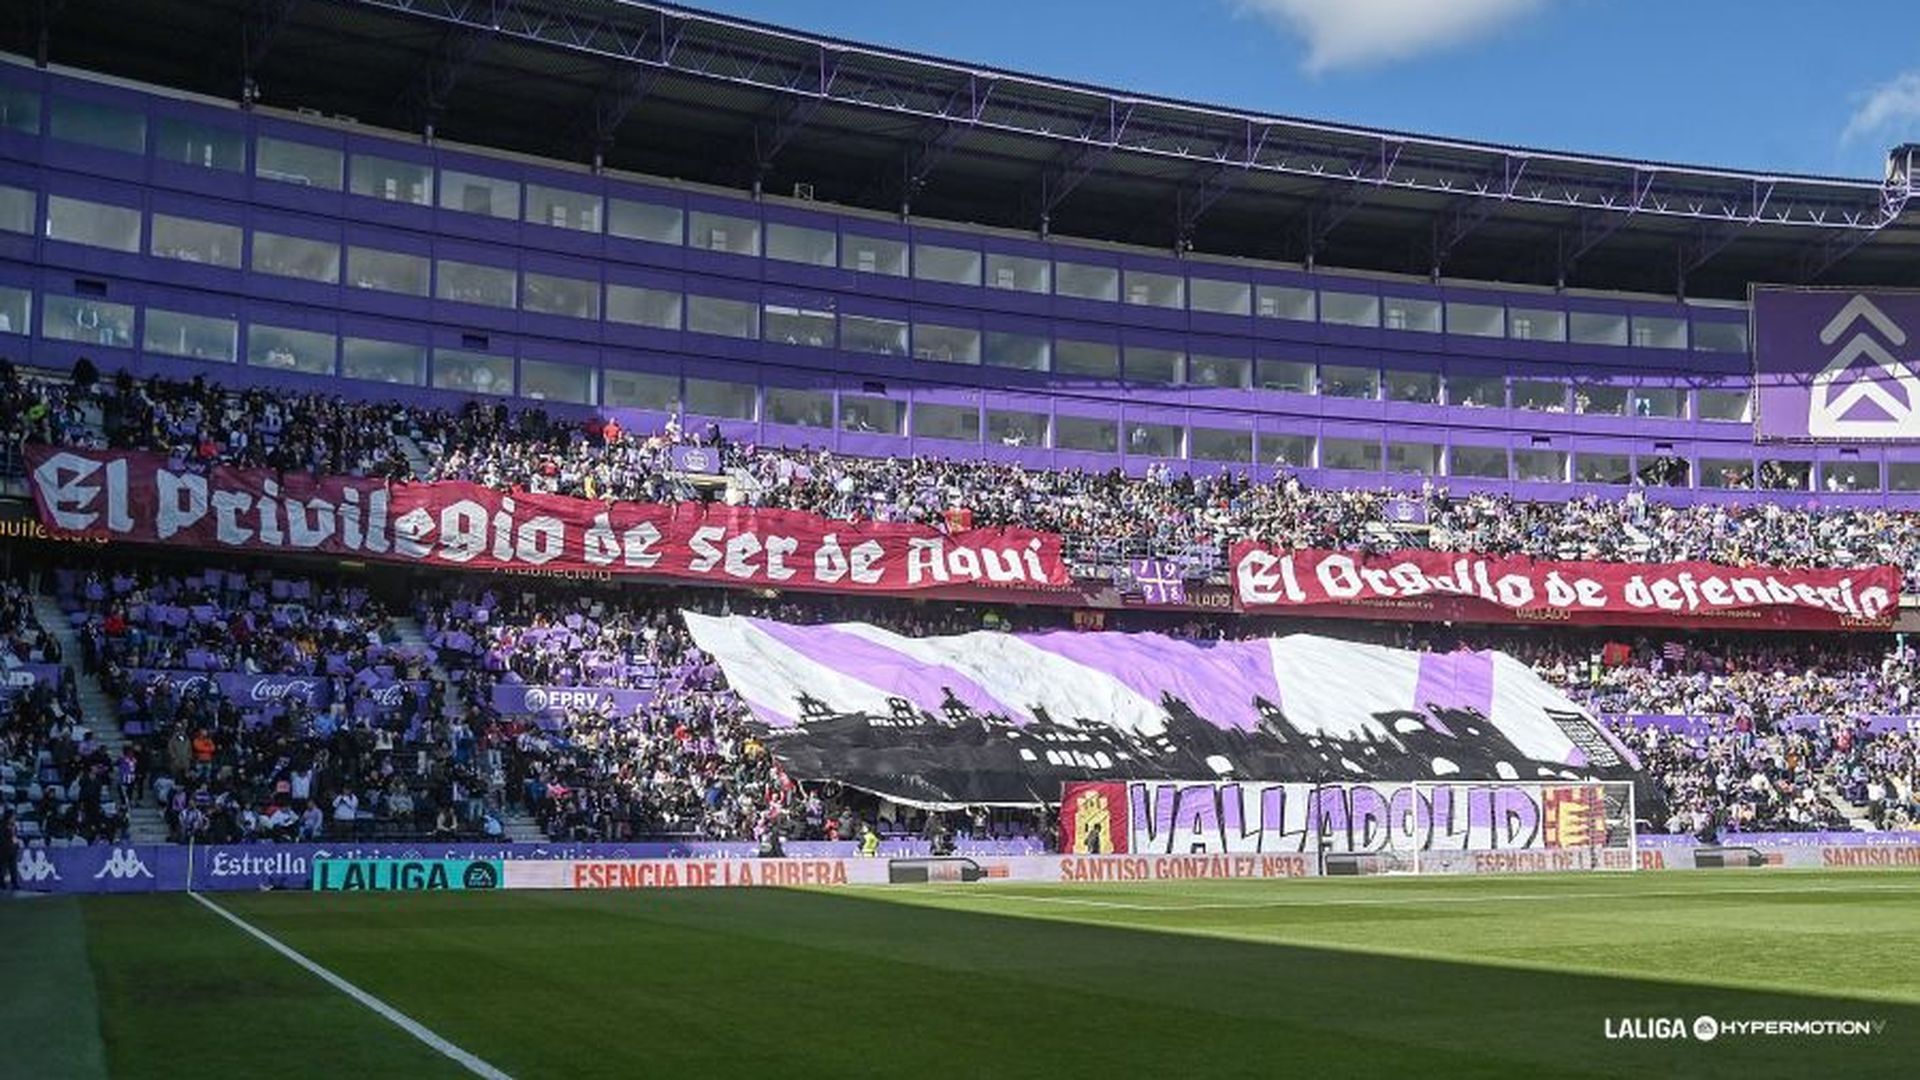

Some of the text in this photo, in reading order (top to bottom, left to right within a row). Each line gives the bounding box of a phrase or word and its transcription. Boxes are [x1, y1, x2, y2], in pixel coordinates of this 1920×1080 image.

[34, 451, 133, 533] El
[584, 512, 662, 568] de
[688, 526, 798, 580] ser
[814, 533, 885, 583] de
[1237, 550, 1305, 603] El
[1545, 570, 1608, 607] de
[1130, 783, 1540, 855] VALLADOLID
[211, 851, 306, 876] Estrella
[321, 862, 448, 889] LALIGA
[574, 862, 847, 889] ESENCIA DE LA RIBERA
[1060, 858, 1148, 881] SANTISO
[1156, 854, 1256, 880] GONZÁLEZ
